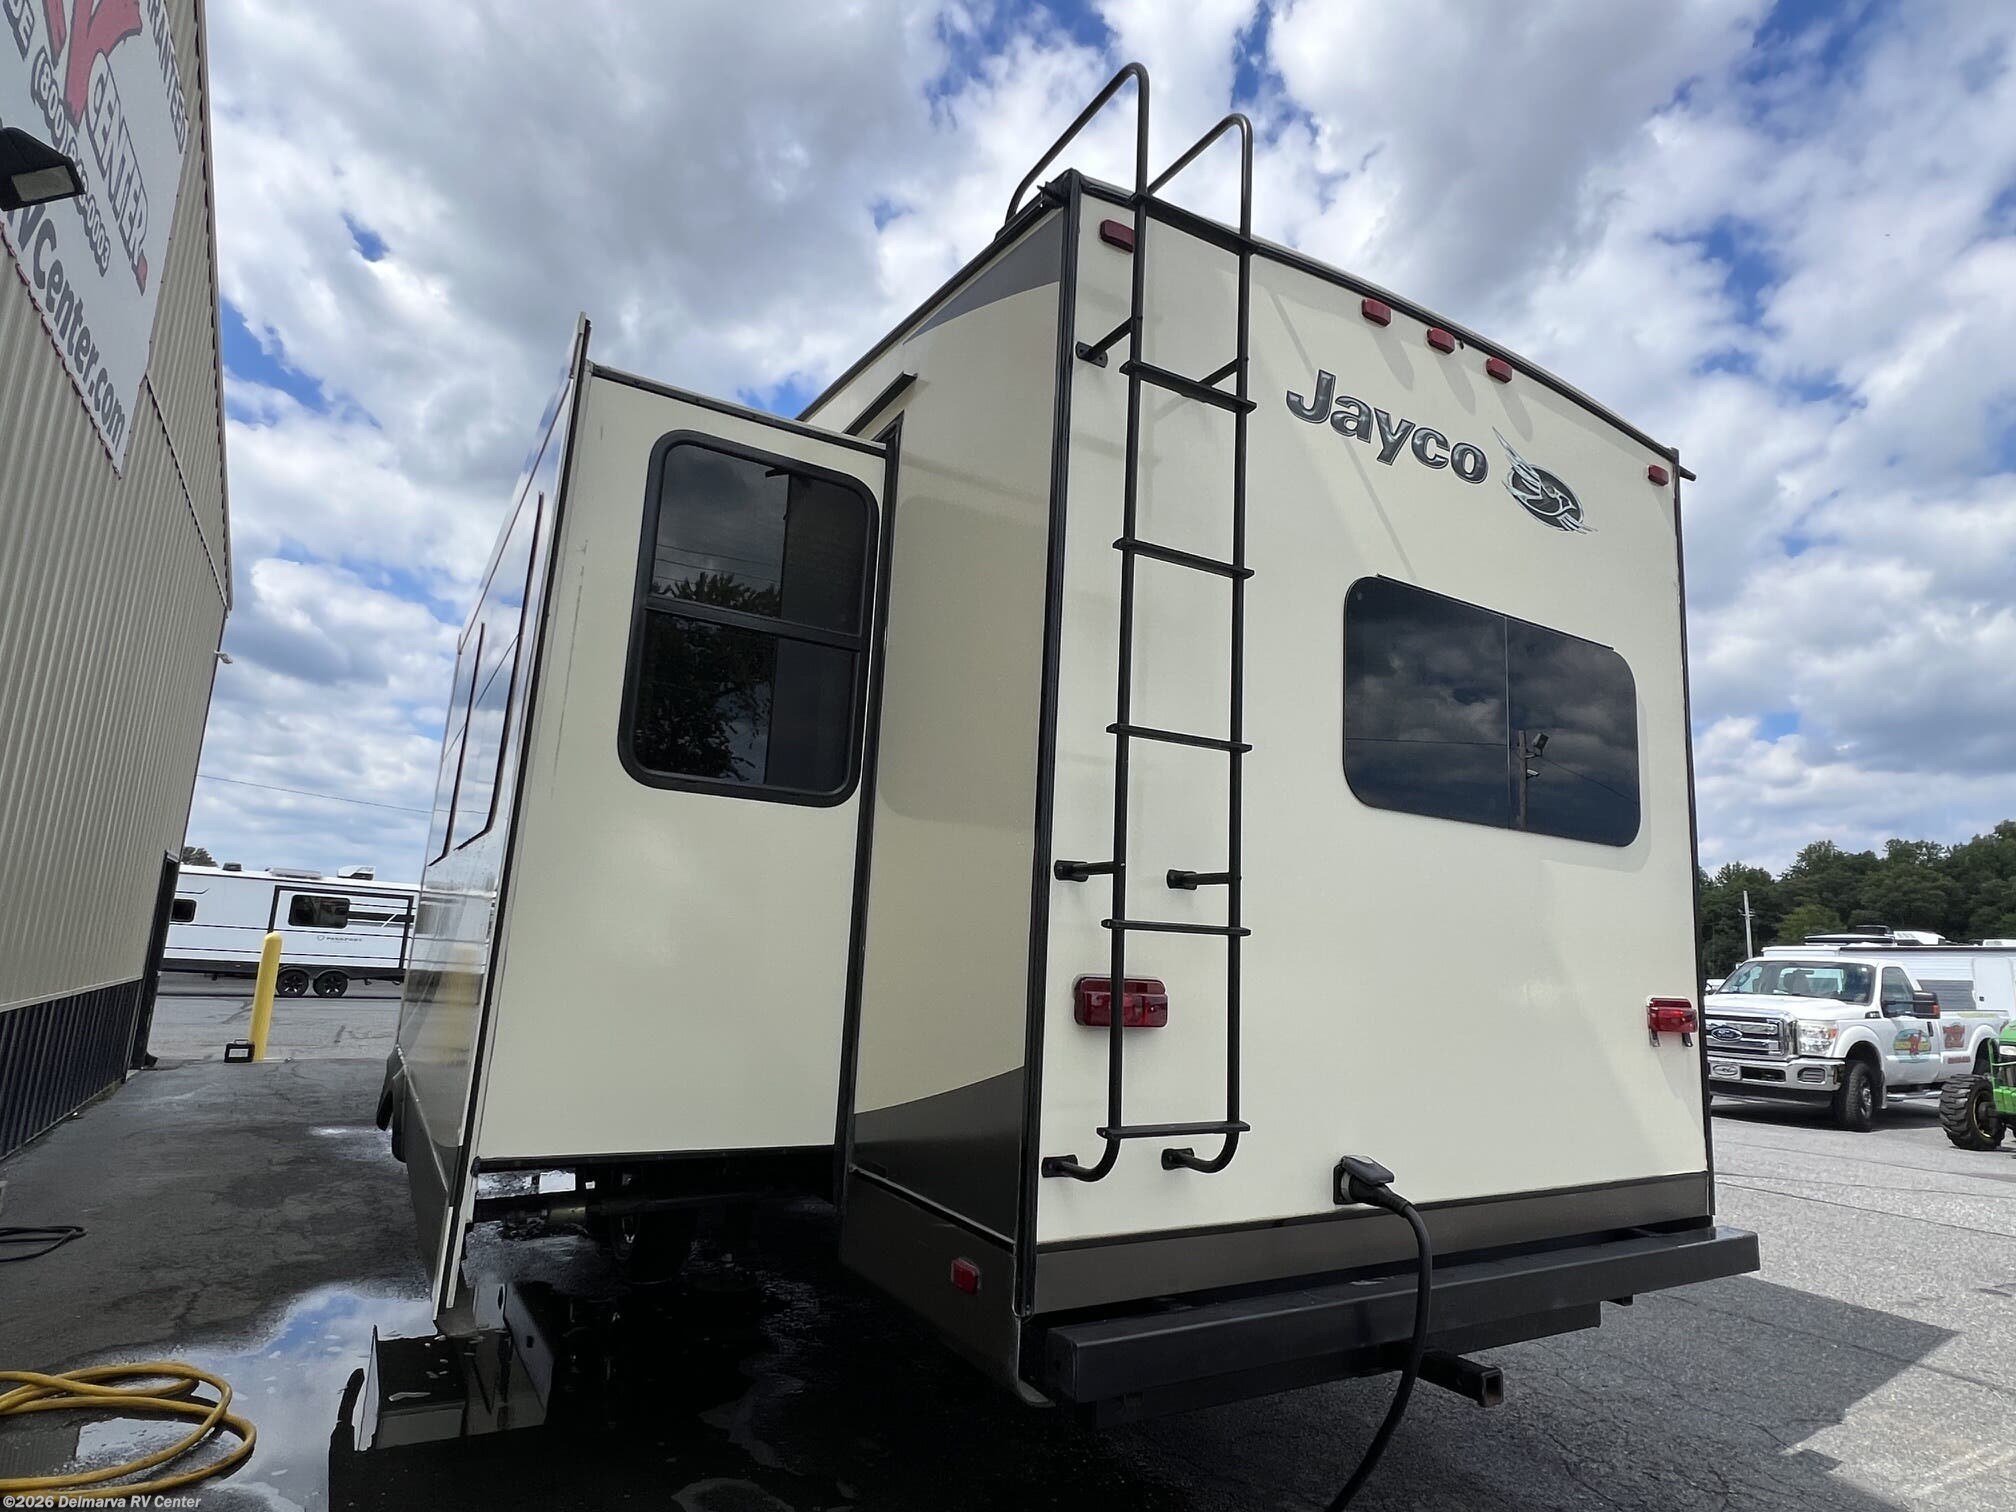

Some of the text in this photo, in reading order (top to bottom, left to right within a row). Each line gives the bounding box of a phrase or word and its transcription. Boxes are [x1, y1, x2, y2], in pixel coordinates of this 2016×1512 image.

[31, 45, 74, 155] (800)
[147, 0, 187, 153] RANTEED
[86, 48, 148, 272] CENTER
[7, 203, 126, 451] VCenter.com
[1286, 369, 1489, 484] Jayco
